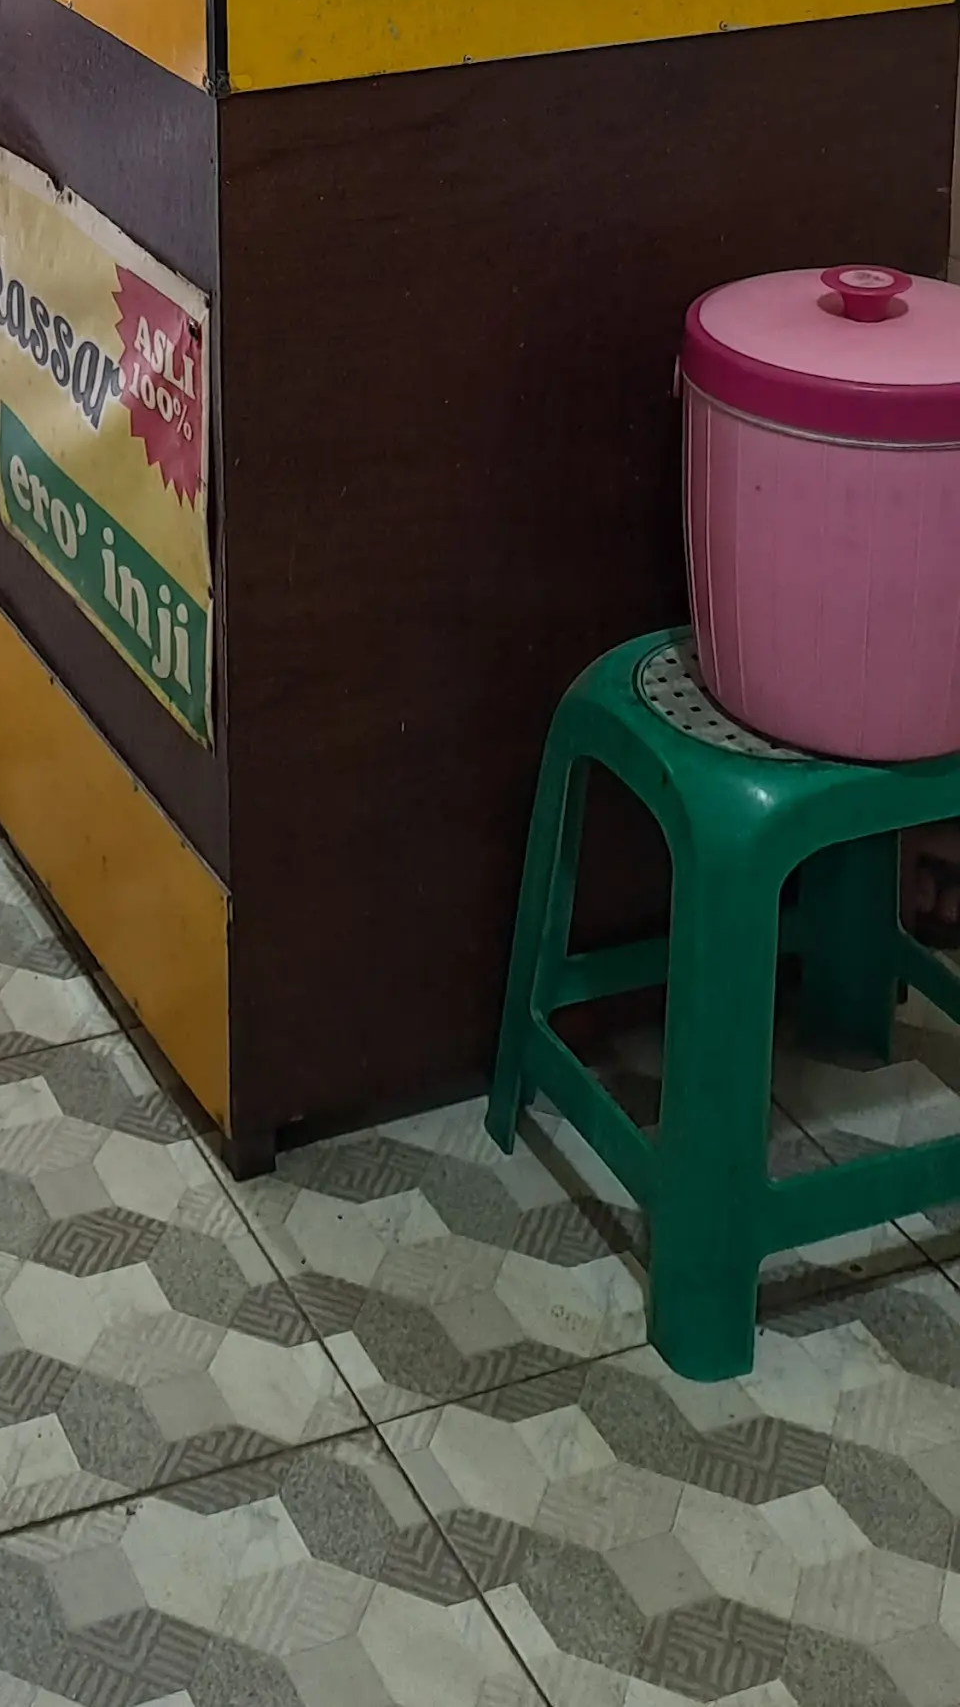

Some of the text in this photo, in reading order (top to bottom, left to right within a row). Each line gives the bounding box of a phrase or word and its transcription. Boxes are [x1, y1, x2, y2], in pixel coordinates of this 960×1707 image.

[134, 316, 195, 400] ASLI
[127, 362, 193, 442] 100%
[101, 527, 191, 695] inji
